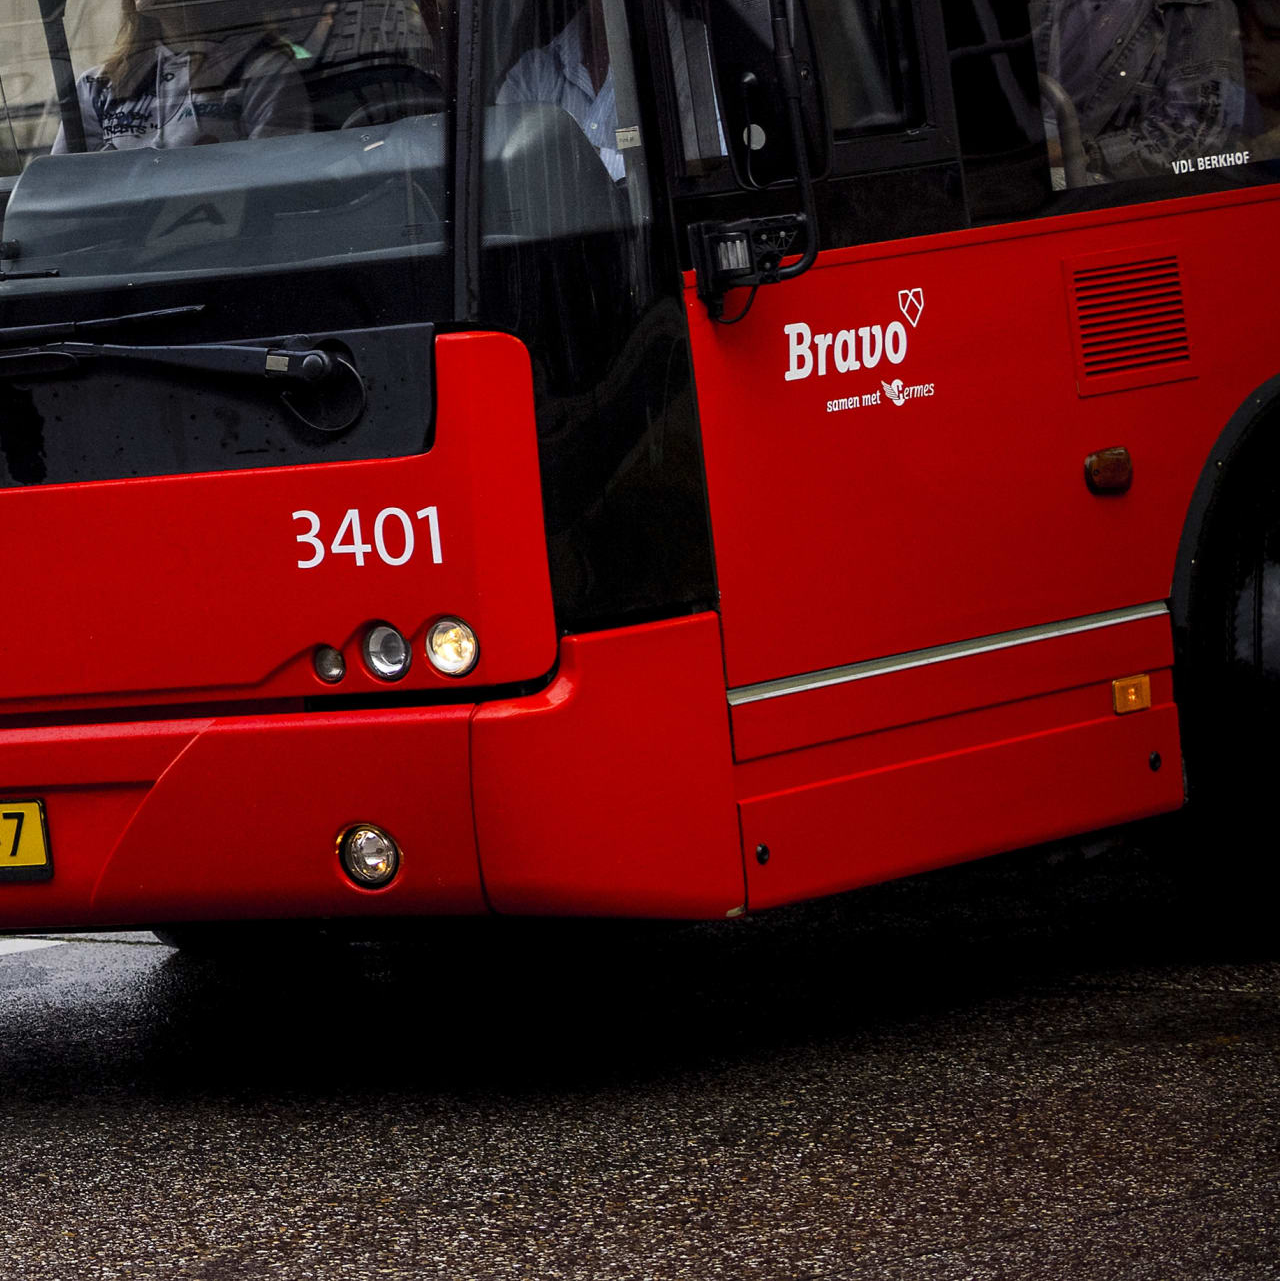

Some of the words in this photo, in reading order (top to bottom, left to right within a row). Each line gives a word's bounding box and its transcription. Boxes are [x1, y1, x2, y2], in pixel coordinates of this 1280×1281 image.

[1171, 159, 1196, 175] VDL
[1196, 151, 1251, 171] BERKHOF
[783, 319, 909, 382] Bravo
[826, 395, 860, 413] samen
[861, 390, 881, 407] met
[292, 506, 443, 569] 3401
